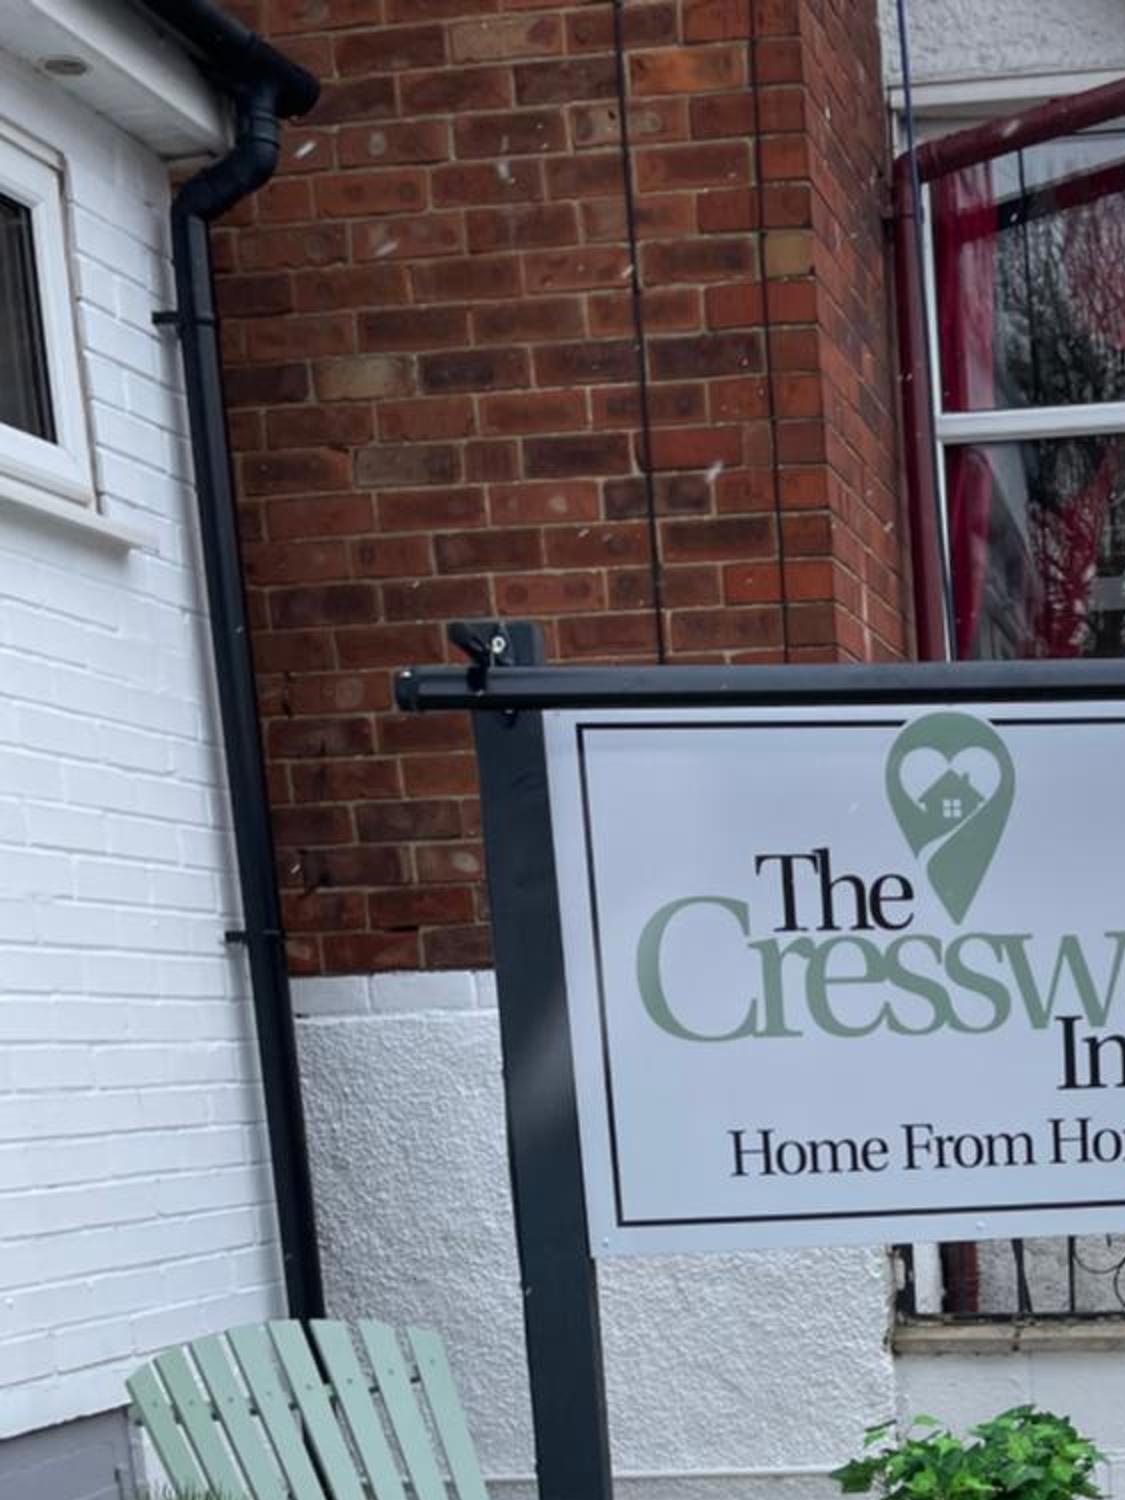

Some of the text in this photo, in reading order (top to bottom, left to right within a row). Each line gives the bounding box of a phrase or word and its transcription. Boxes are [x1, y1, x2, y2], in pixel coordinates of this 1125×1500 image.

[754, 847, 915, 933] The
[727, 1128, 889, 1178] Home
[901, 1123, 1036, 1171] From
